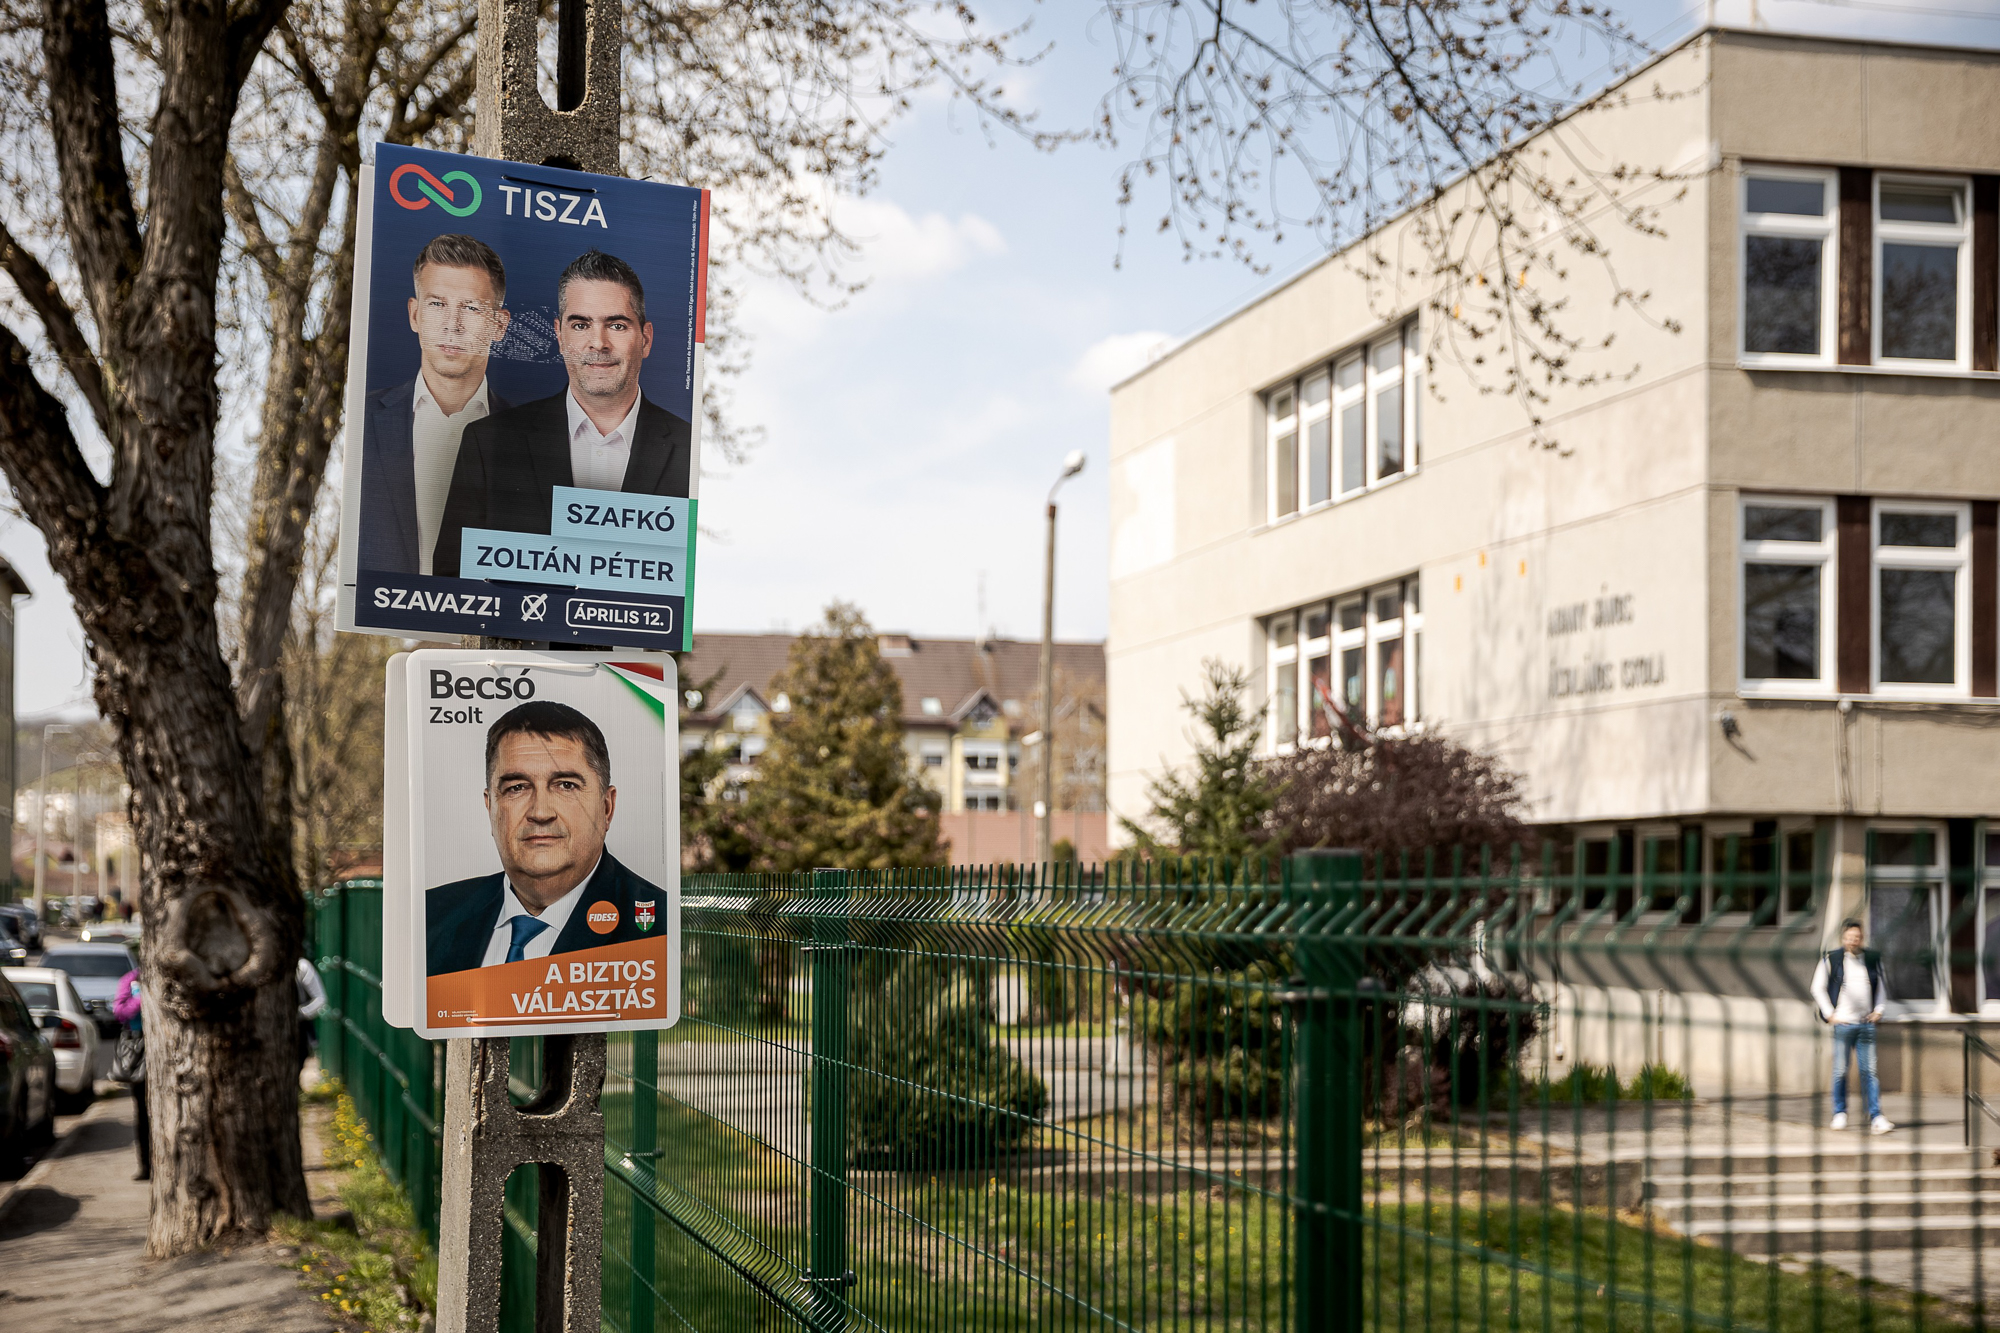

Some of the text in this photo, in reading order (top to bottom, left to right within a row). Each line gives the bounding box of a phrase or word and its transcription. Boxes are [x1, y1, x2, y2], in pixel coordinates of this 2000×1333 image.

[498, 184, 608, 229] TISZA
[566, 503, 675, 532] SZAFKÓ
[476, 545, 675, 582] ZOLTÁN PÉTER
[373, 587, 501, 618] SZAVAZZ!
[573, 603, 664, 627] ÁPRILIS 12.
[429, 668, 535, 700] Becsó
[429, 706, 483, 724] Zsolt
[588, 913, 618, 922] FIDESZ
[544, 959, 656, 985] A BIZTOS
[511, 982, 656, 1014] VÁLASZTÁS
[437, 1010, 450, 1018] 01.
